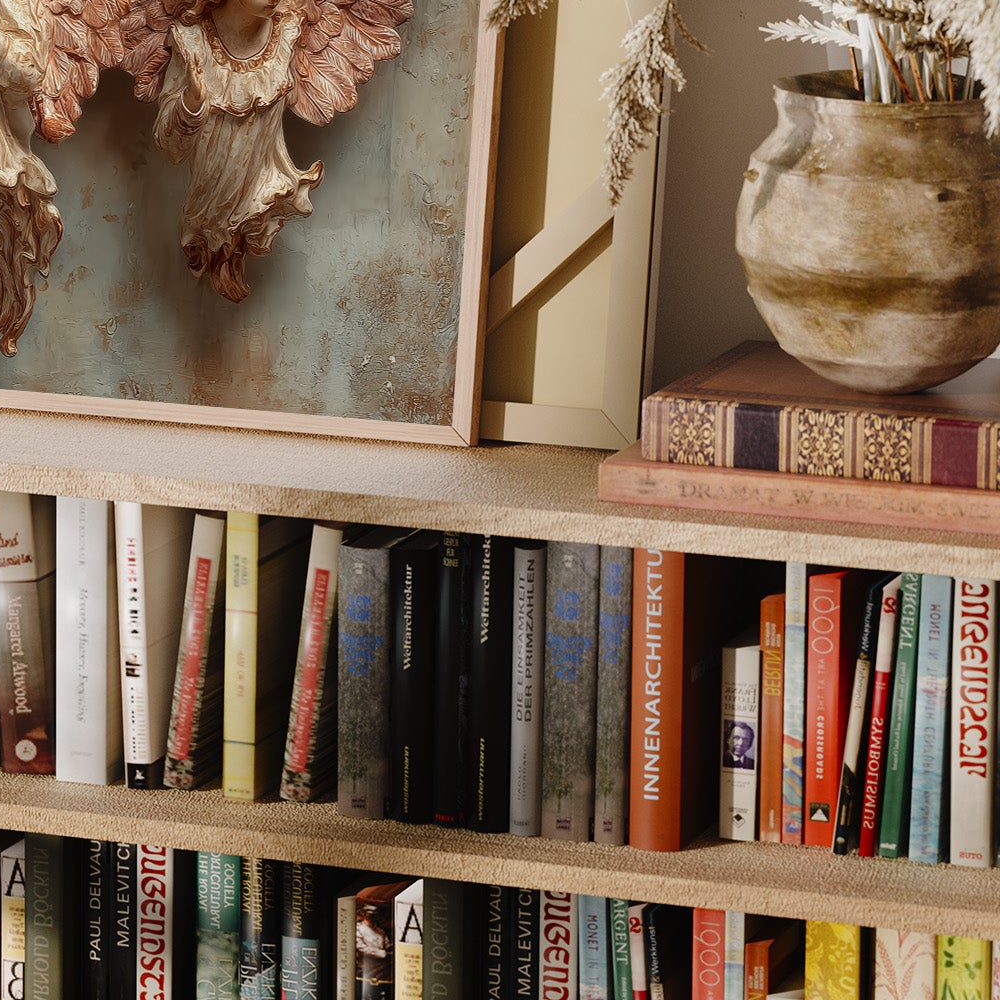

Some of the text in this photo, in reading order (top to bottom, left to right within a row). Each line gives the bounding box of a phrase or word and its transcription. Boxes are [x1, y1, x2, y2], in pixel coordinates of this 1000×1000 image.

[402, 563, 412, 670] Weltarchitektur
[516, 574, 525, 685] EINSAMKEIT
[524, 559, 534, 722] DER PRIMZAHLEN
[5, 594, 32, 713] Margaret Atwood
[477, 737, 485, 820] westermann
[89, 916, 101, 961] PAUL
[400, 903, 423, 942] A
[586, 914, 599, 951] MONET
[629, 916, 641, 933] 2
[648, 926, 659, 974] Werkkunst
[488, 963, 501, 1000] AUL
[695, 921, 720, 986] 1900
